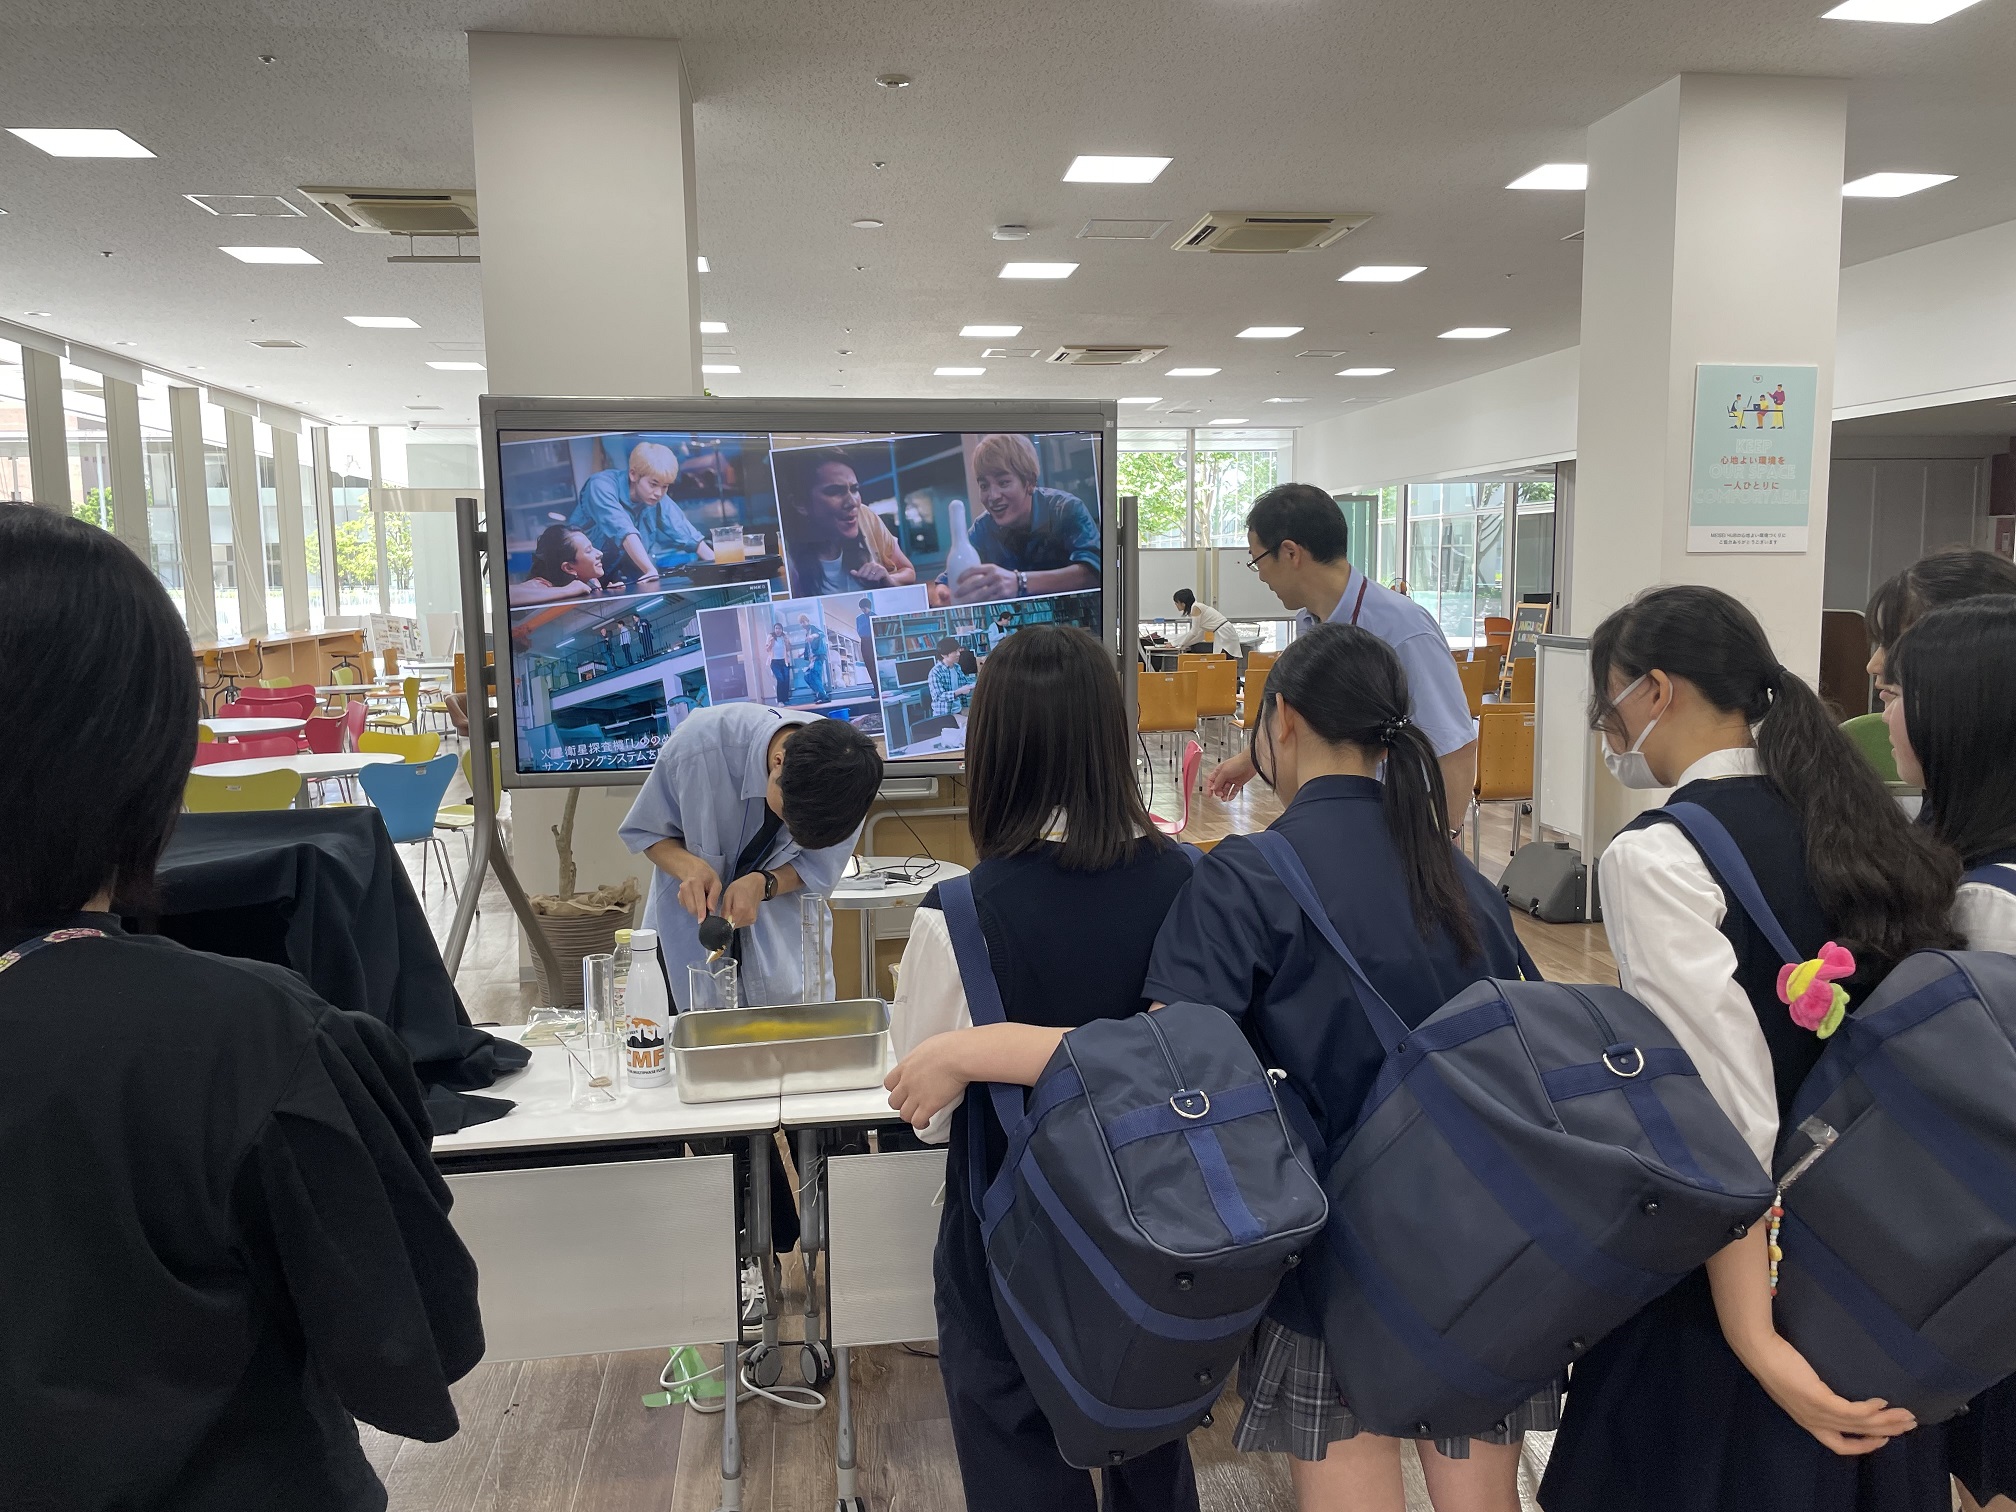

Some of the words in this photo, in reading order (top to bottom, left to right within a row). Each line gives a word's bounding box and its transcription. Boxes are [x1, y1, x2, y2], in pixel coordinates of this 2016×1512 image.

[1736, 439, 1772, 453] KEEP
[1721, 456, 1785, 465] 心地よい環境を
[1709, 464, 1745, 479] OUR
[1749, 464, 1796, 480] SPACE
[1723, 481, 1780, 490] 一人ひとりに
[542, 748, 660, 771] サンプリングシステムを
